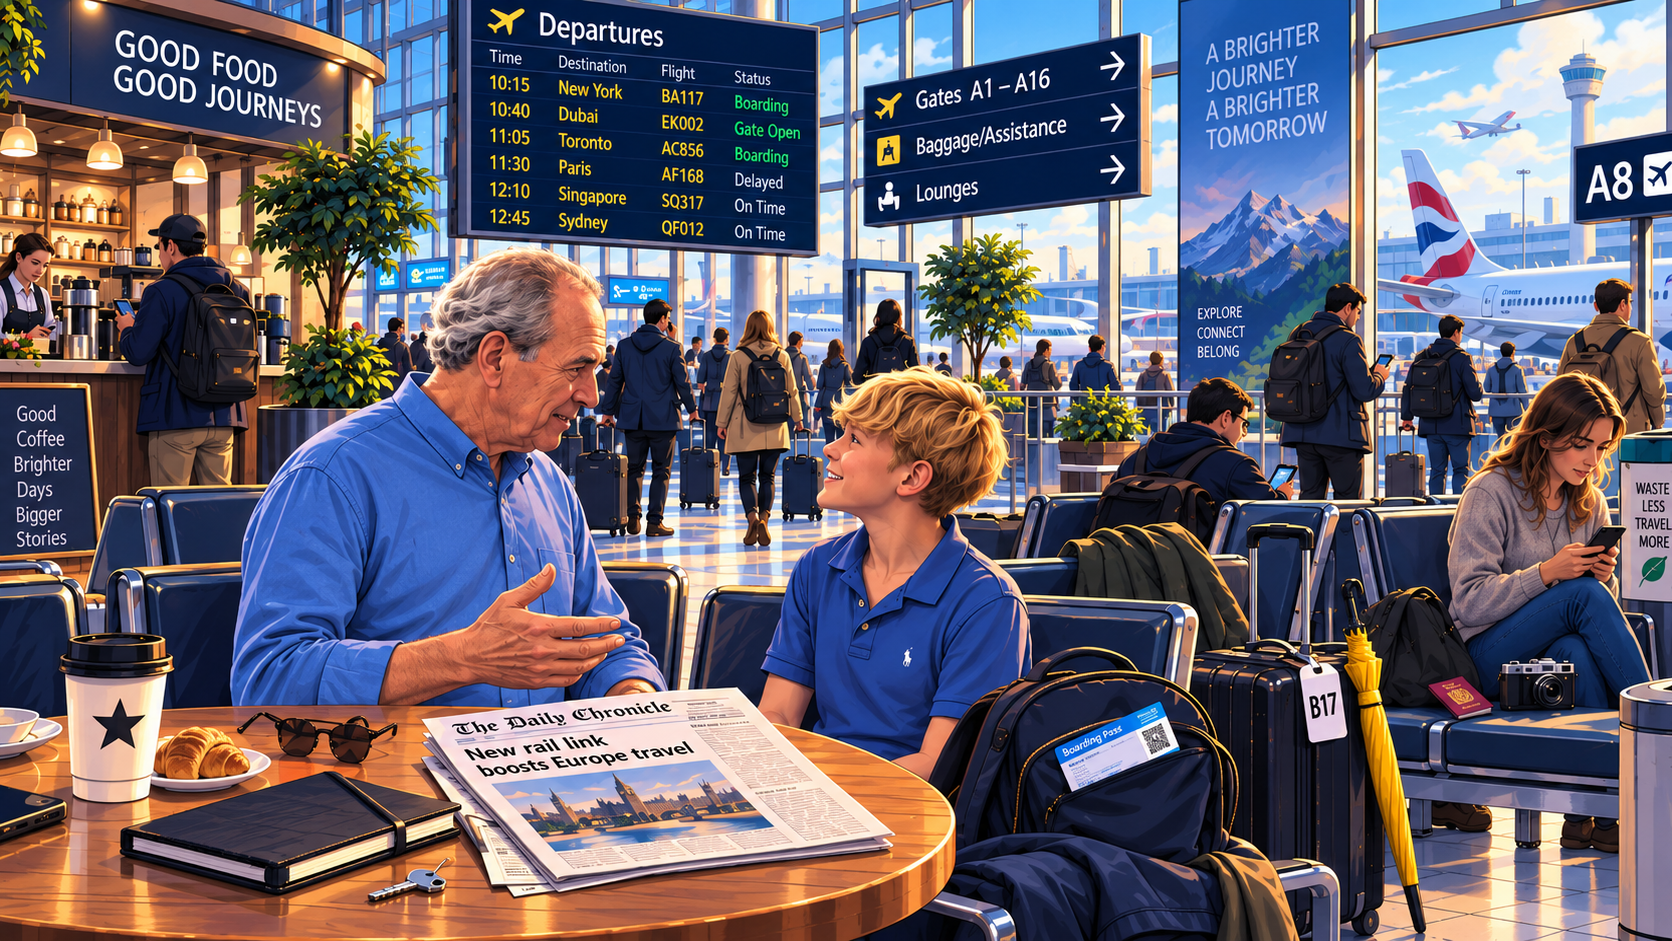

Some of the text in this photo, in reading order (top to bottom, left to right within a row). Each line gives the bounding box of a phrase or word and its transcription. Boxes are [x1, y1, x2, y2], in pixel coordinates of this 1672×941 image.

[540, 12, 663, 47] Departures
[1206, 22, 1319, 64] A BRIGHTER
[115, 30, 278, 88] GOOD FOOD
[490, 50, 770, 85] Time Destination Flight Status
[1206, 55, 1298, 93] JOURNEY
[114, 65, 322, 129] GOOD JOURNEYS
[490, 75, 788, 116] 10:15 New York BA117 Boarding
[916, 89, 961, 109] Gates
[971, 77, 991, 101] A1
[1015, 68, 1050, 93] A16
[1206, 82, 1319, 121] A BRIGHTER
[490, 102, 800, 141] 10:40 Dubai EK002 Gate Open
[1206, 110, 1327, 149] TOMORROW
[490, 128, 788, 167] 11:05 Toronto AC856 Boarding
[917, 119, 1067, 157] Baggage/Assistance
[490, 155, 782, 191] 11:30 Paris AF168 Delayed
[1586, 162, 1633, 203] A8
[490, 182, 785, 215] 12:10 Singapore SQ317 On Time
[917, 182, 978, 202] Lounges
[490, 209, 785, 241] 12:45 Sydney QF012 On Time
[1198, 306, 1242, 319] EXPLORE
[1198, 326, 1245, 339] CONNECT
[1198, 345, 1239, 358] BELONG
[17, 405, 55, 421] Good
[17, 430, 64, 446] Coffee
[15, 455, 72, 476] Brighter
[18, 482, 52, 501] Days
[1636, 482, 1669, 495] WASTE
[17, 507, 62, 526] Bigger
[1643, 500, 1665, 512] LESS
[17, 530, 66, 547] Stories
[1635, 517, 1672, 530] TRAVEL
[1640, 535, 1669, 548] MORE
[452, 722, 499, 735] The
[504, 713, 567, 730] Daily
[572, 701, 672, 721] Chronicle
[1309, 692, 1336, 719] B17
[464, 735, 609, 761] New rail link
[1062, 735, 1102, 757] Boarding
[1103, 726, 1122, 739] Pass
[476, 741, 695, 777] boosts Europe travel
